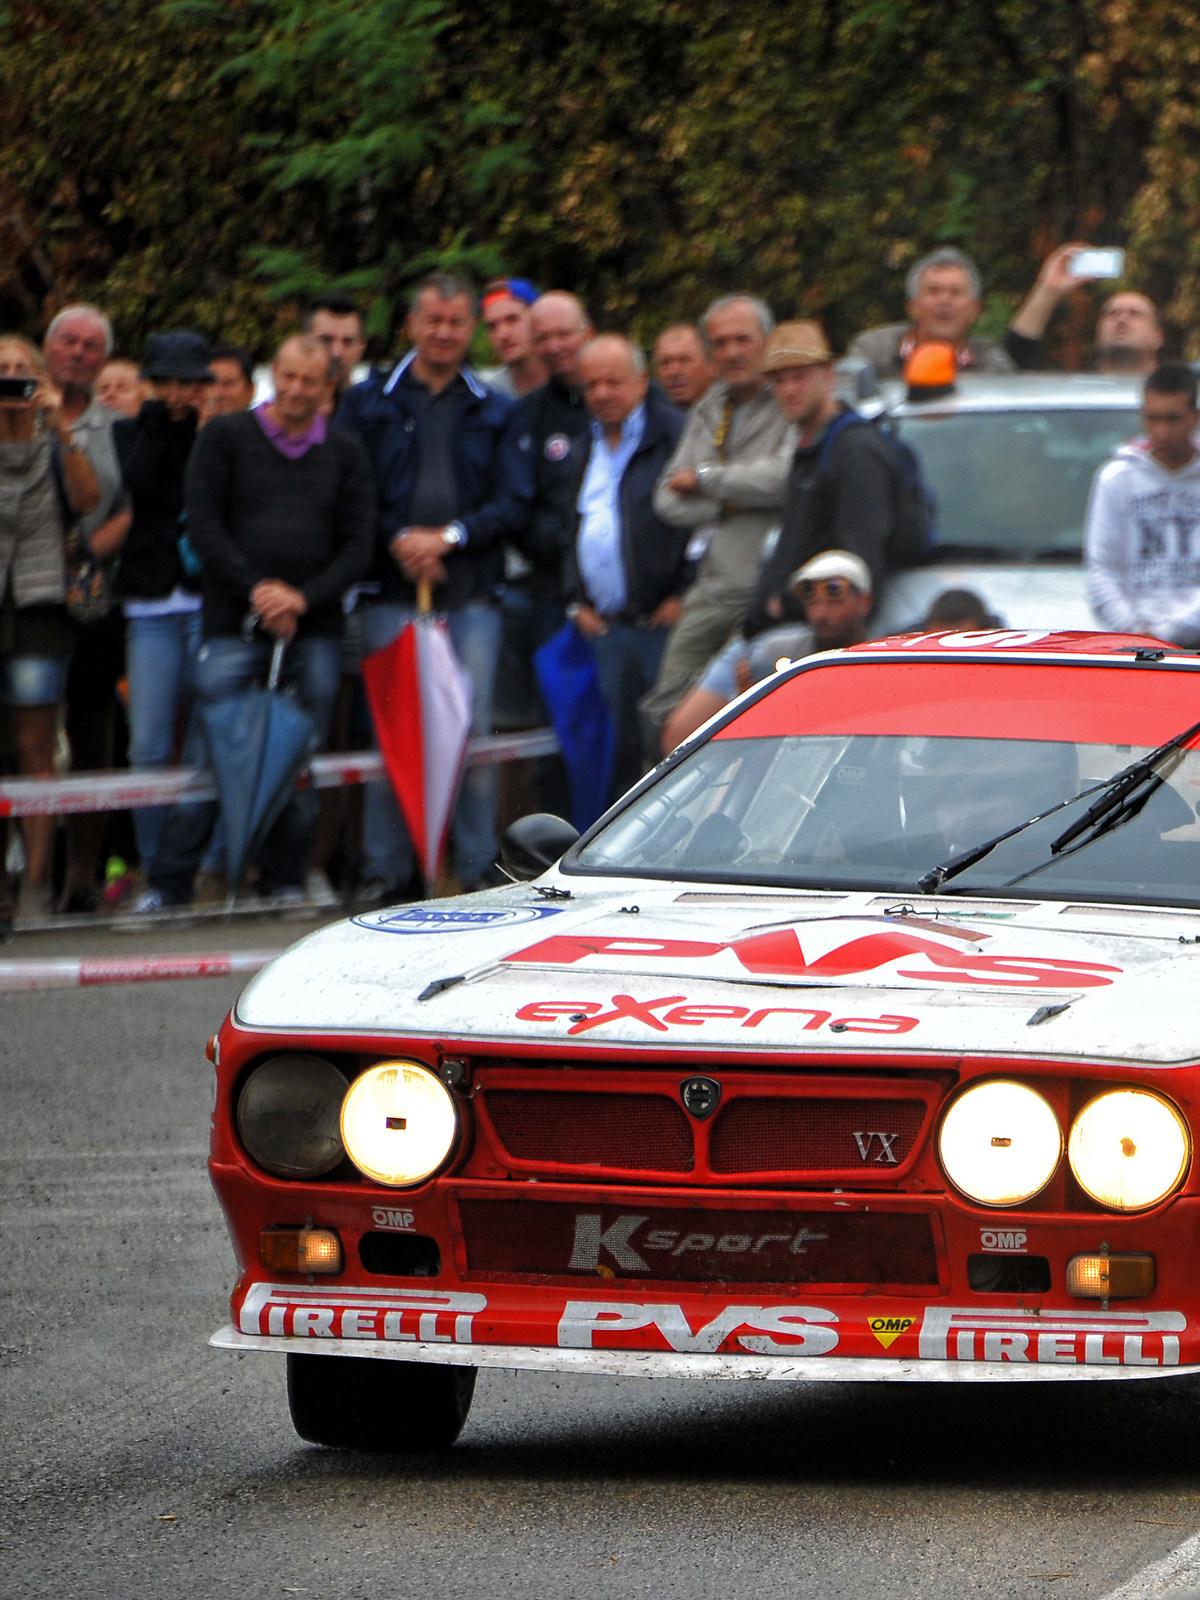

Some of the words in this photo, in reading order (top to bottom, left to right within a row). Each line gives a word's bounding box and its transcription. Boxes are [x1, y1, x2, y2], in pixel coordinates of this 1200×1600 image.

[500, 928, 1125, 988] PVS
[852, 1131, 898, 1164] VX
[371, 1208, 415, 1229] OMP
[980, 1231, 1027, 1250] OMP
[241, 1282, 488, 1344] PIRELLI
[556, 1299, 841, 1357] PVS
[869, 1317, 912, 1332] OMP
[917, 1306, 1188, 1366] PIRELLI
